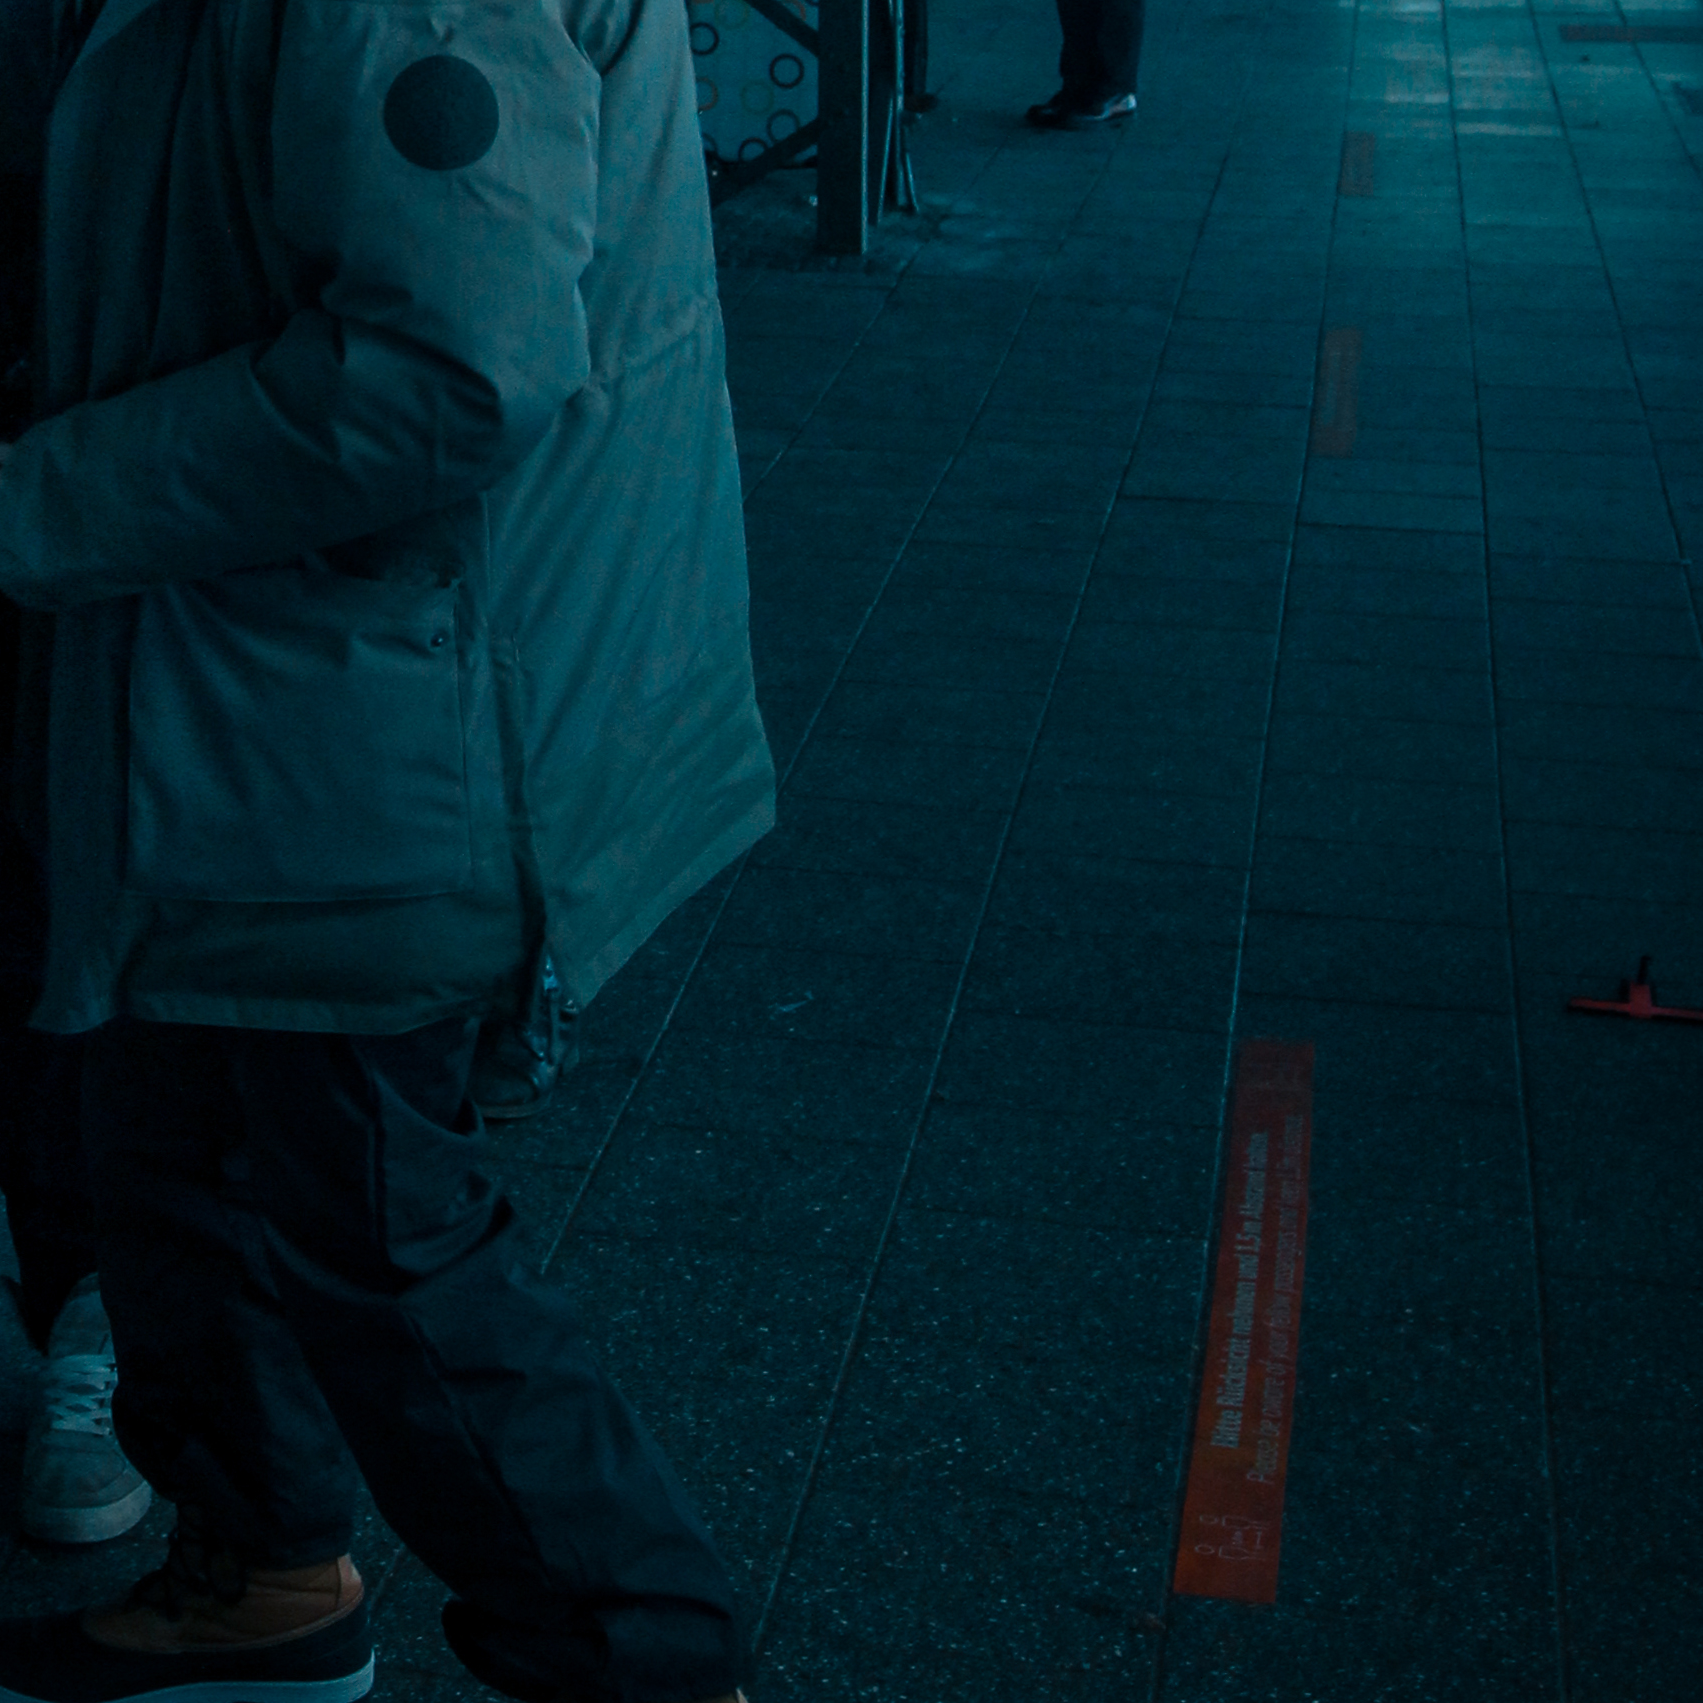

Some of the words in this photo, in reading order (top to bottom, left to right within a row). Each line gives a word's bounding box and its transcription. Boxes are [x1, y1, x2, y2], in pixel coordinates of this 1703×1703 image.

[1233, 1253, 1259, 1280] und
[1227, 1281, 1257, 1335] nehmen
[1215, 1338, 1251, 1407] Rücksicht
[1209, 1410, 1243, 1449] Bitte
[1252, 1419, 1281, 1437] be
[1246, 1439, 1279, 1485] Please
